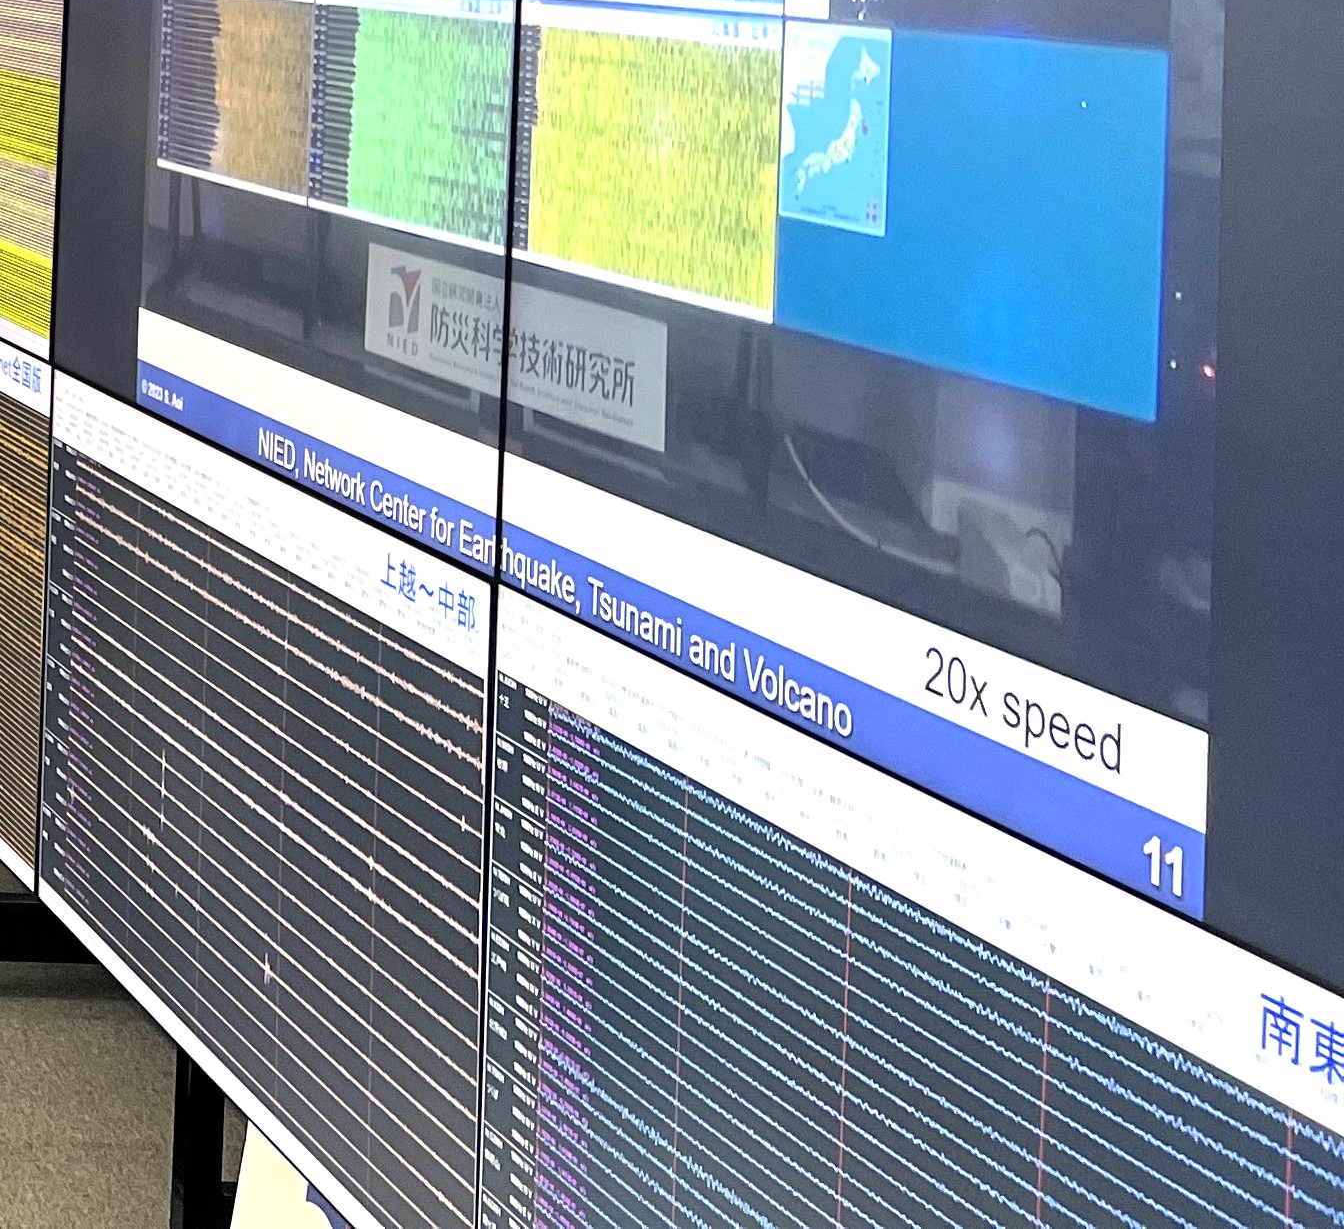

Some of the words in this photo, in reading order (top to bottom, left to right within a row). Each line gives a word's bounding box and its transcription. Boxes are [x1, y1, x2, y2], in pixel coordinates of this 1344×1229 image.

[387, 332, 419, 357] NIED
[258, 427, 299, 479] NIED,
[303, 447, 366, 507] Network
[370, 480, 427, 534] Center
[430, 507, 455, 547] for
[587, 577, 683, 657] Tsunami
[689, 632, 736, 683] and
[743, 648, 854, 739] Volcano
[924, 647, 989, 718] 20x
[1002, 690, 1122, 774] speed
[1143, 835, 1185, 898] 11
